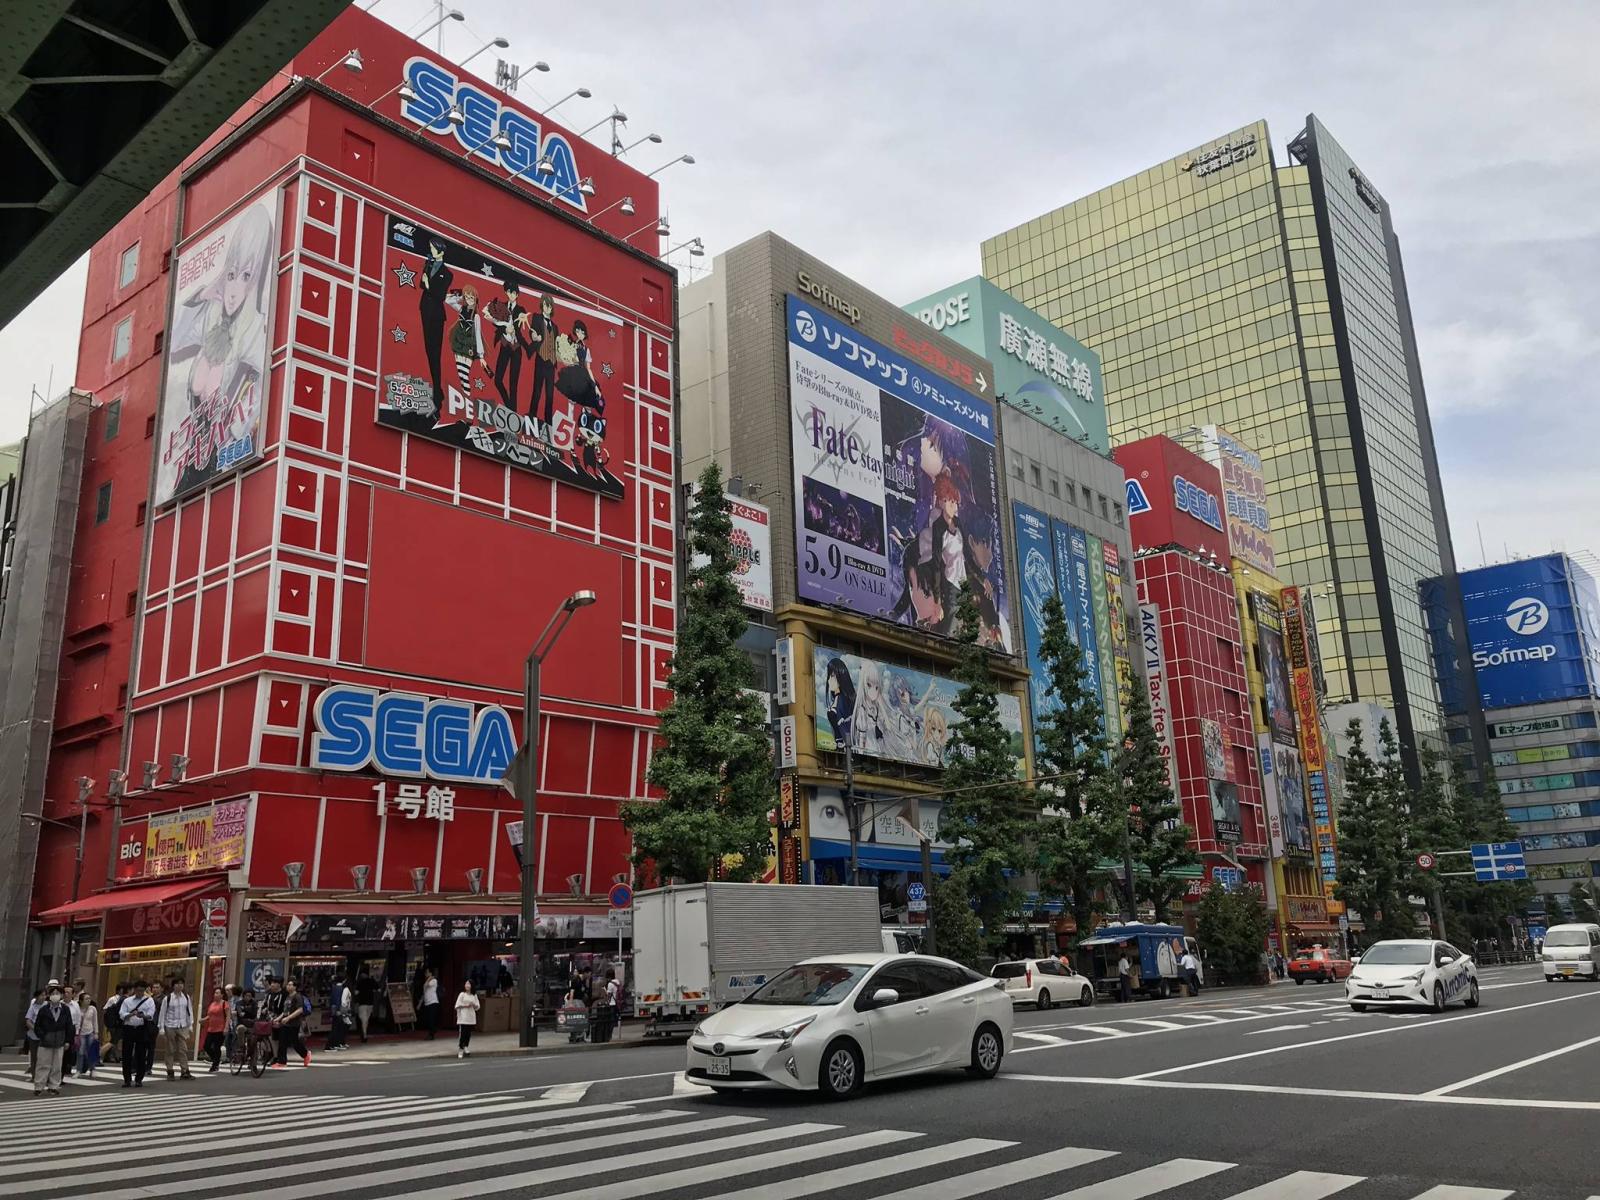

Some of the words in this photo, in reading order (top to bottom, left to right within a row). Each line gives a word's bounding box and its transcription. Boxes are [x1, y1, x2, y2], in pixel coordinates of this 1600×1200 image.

[400, 56, 588, 214] SEGA
[180, 255, 215, 291] BREAK
[181, 235, 225, 277] BORDER
[798, 271, 861, 324] Sofmap
[916, 292, 970, 331] ROSE
[823, 325, 908, 386] ソフマップ
[1000, 311, 1094, 402] 廣瀬無線
[448, 384, 553, 446] PERSONA
[553, 419, 574, 447] 5
[216, 433, 253, 471] SEGA
[811, 404, 860, 465] Fate
[861, 452, 884, 481] stay
[885, 460, 916, 490] night
[724, 503, 762, 521] すぐよこ!
[1174, 475, 1224, 533] SEGA
[805, 535, 841, 580] 5.9
[845, 571, 859, 589] ON
[861, 575, 886, 598] SALE
[1141, 609, 1158, 656] AKKY
[1473, 644, 1556, 668] Sofmap
[310, 684, 520, 786] SEGA
[783, 725, 792, 757] GPS
[1261, 747, 1272, 776] SEGA
[372, 782, 456, 822] 1号館
[121, 839, 142, 860] BIG
[1421, 856, 1432, 865] 50
[909, 887, 923, 895] 437
[146, 903, 184, 931] 宝くじ
